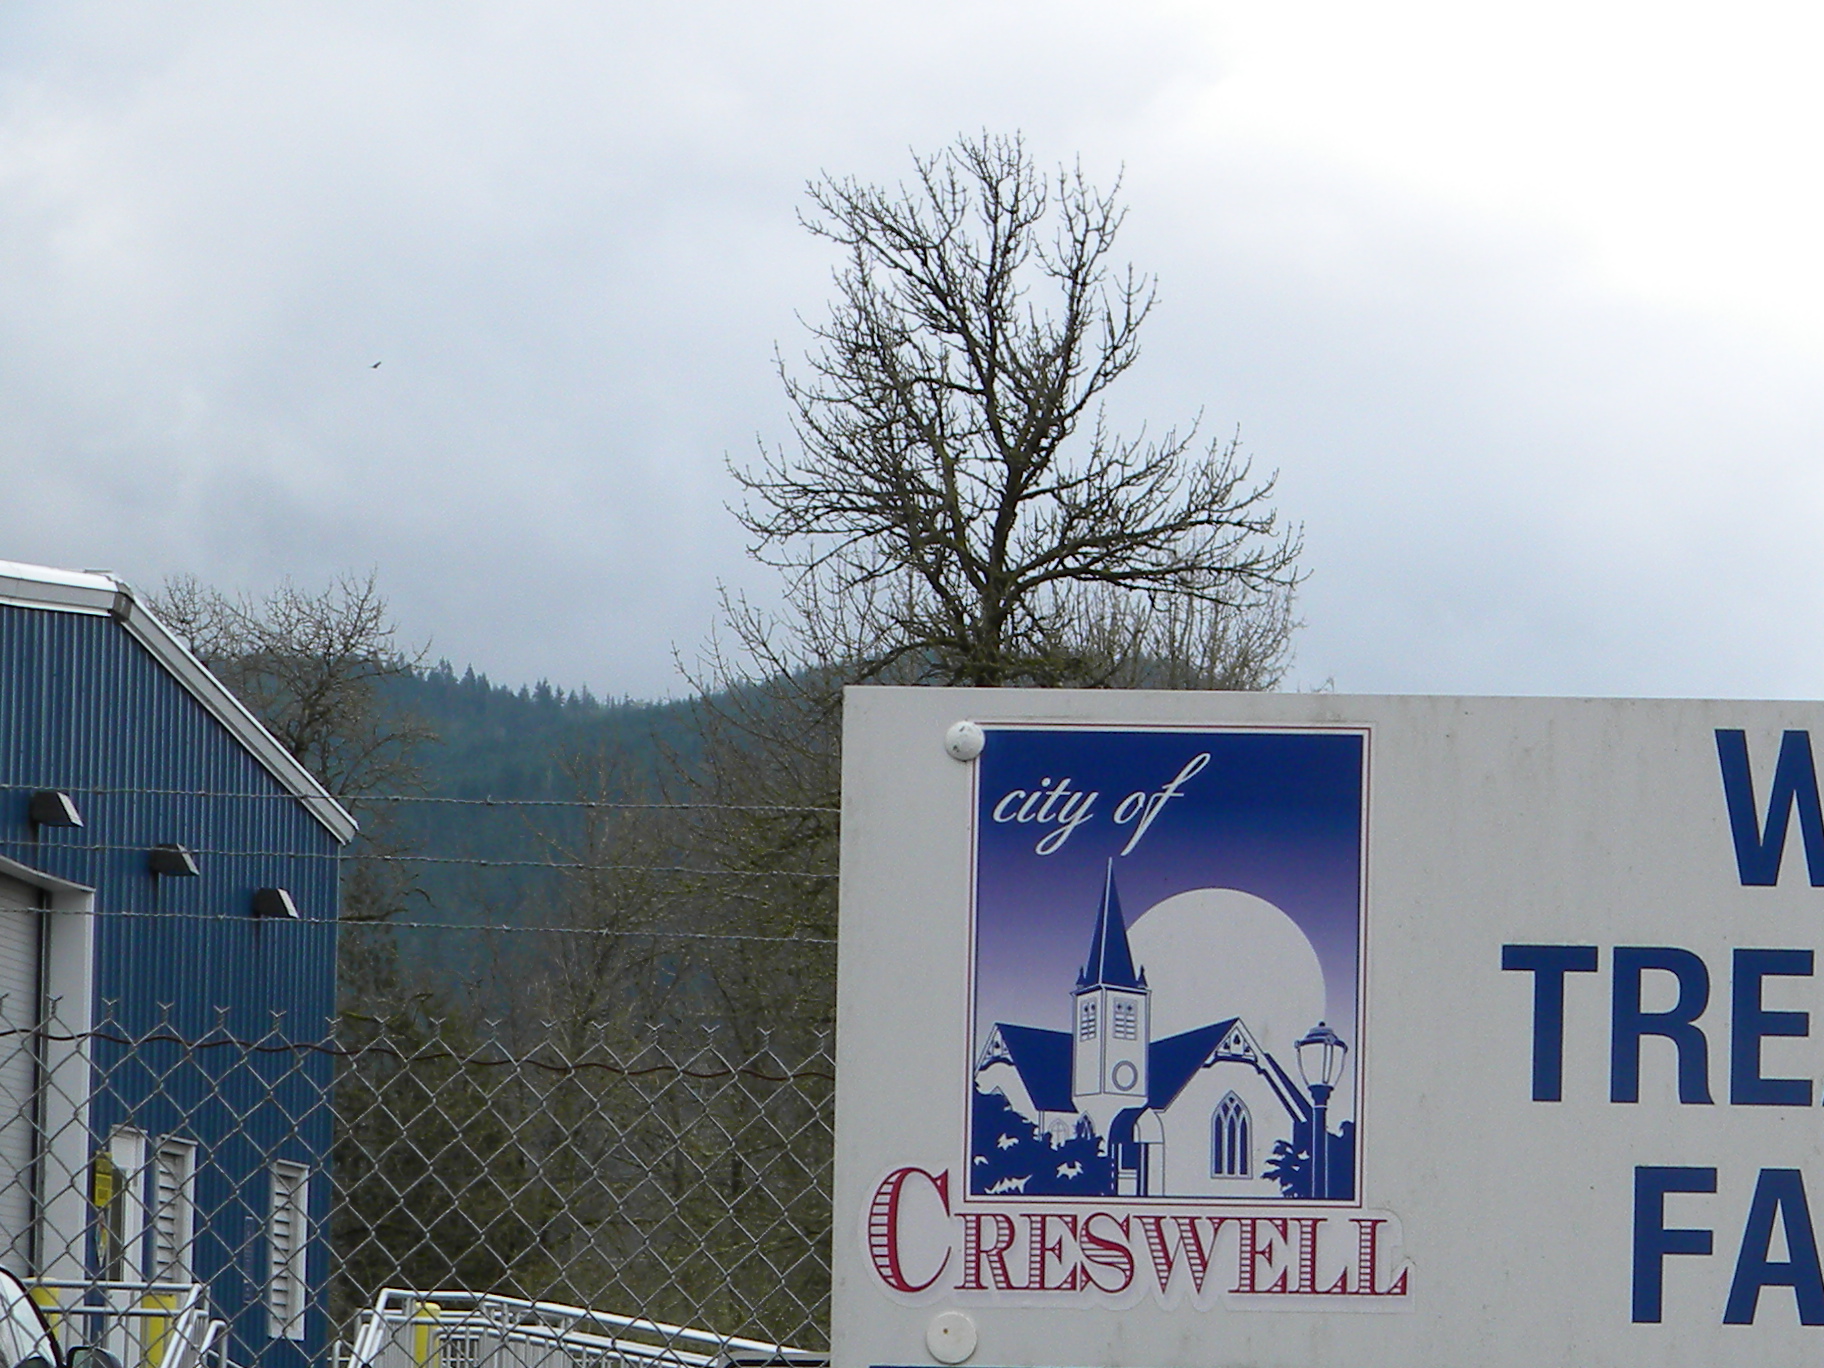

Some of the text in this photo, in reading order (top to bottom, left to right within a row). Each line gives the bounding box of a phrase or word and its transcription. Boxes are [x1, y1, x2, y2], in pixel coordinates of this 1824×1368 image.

[992, 752, 1212, 857] city of
[867, 1166, 1409, 1297] CRESWELL
